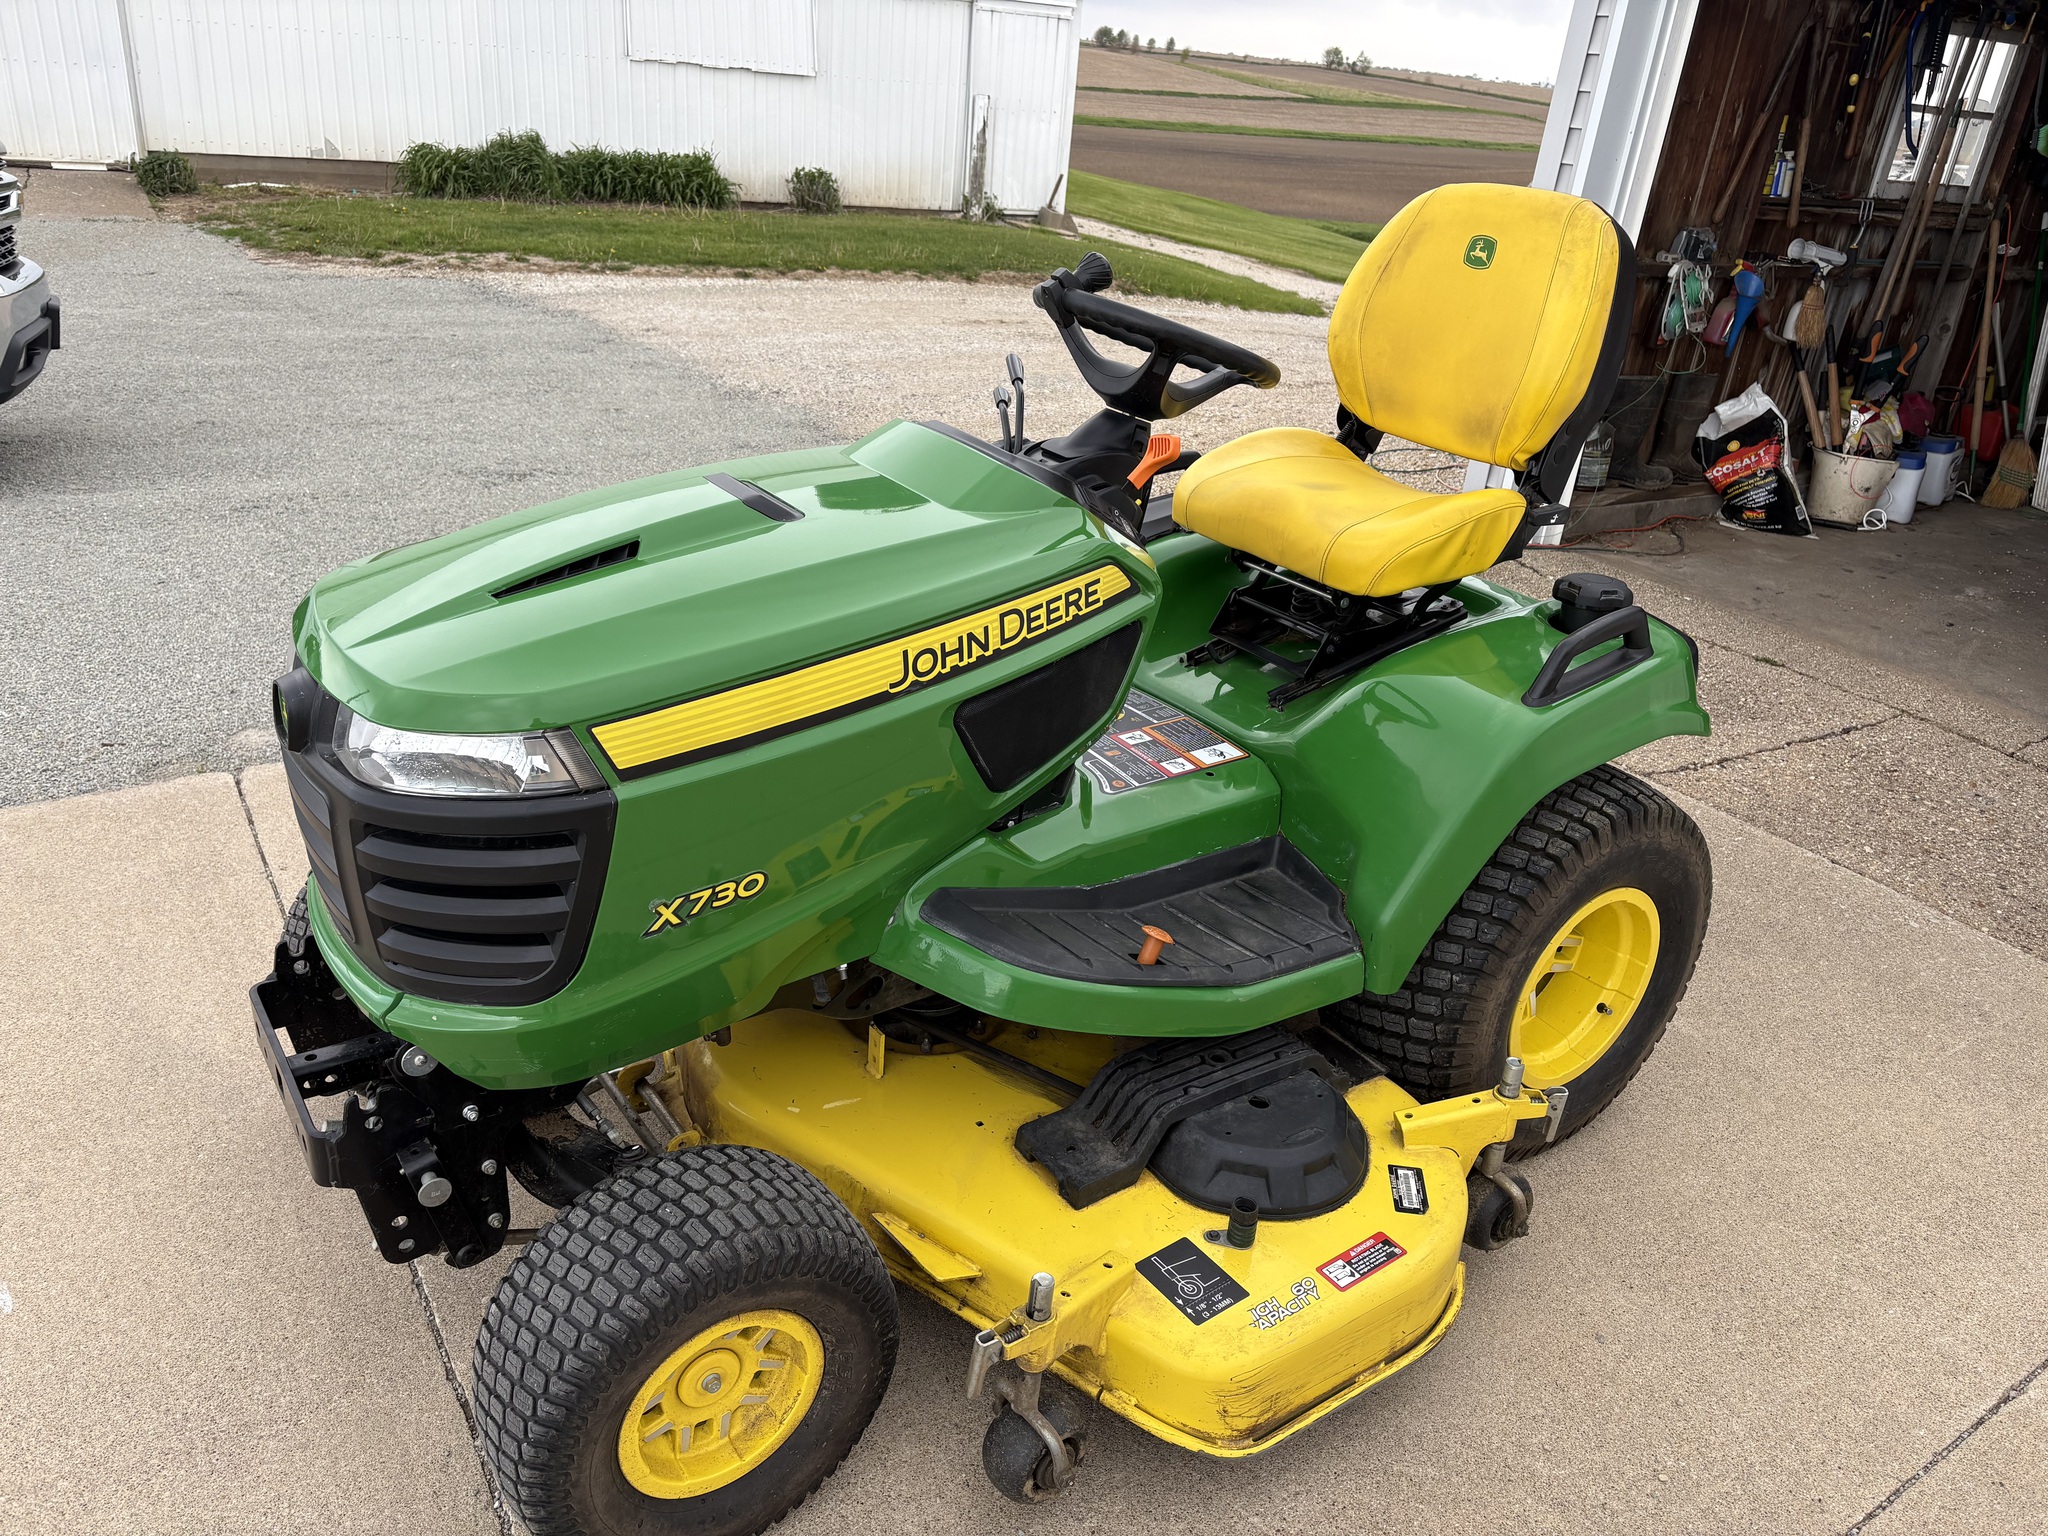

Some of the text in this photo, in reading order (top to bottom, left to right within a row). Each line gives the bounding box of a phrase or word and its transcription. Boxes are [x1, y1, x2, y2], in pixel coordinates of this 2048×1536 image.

[1706, 445, 1769, 480] ECOSALT
[889, 577, 1102, 690] JOHN DEERE
[645, 872, 767, 934] X730
[1351, 1250, 1371, 1263] ROTATING
[1370, 1242, 1383, 1252] BLADE
[1355, 1239, 1375, 1252] DANGER
[1291, 1276, 1317, 1297] 60
[1196, 1301, 1207, 1311] 1/8"
[1212, 1292, 1223, 1302] 1/2"
[1213, 1298, 1234, 1312] 13MM)
